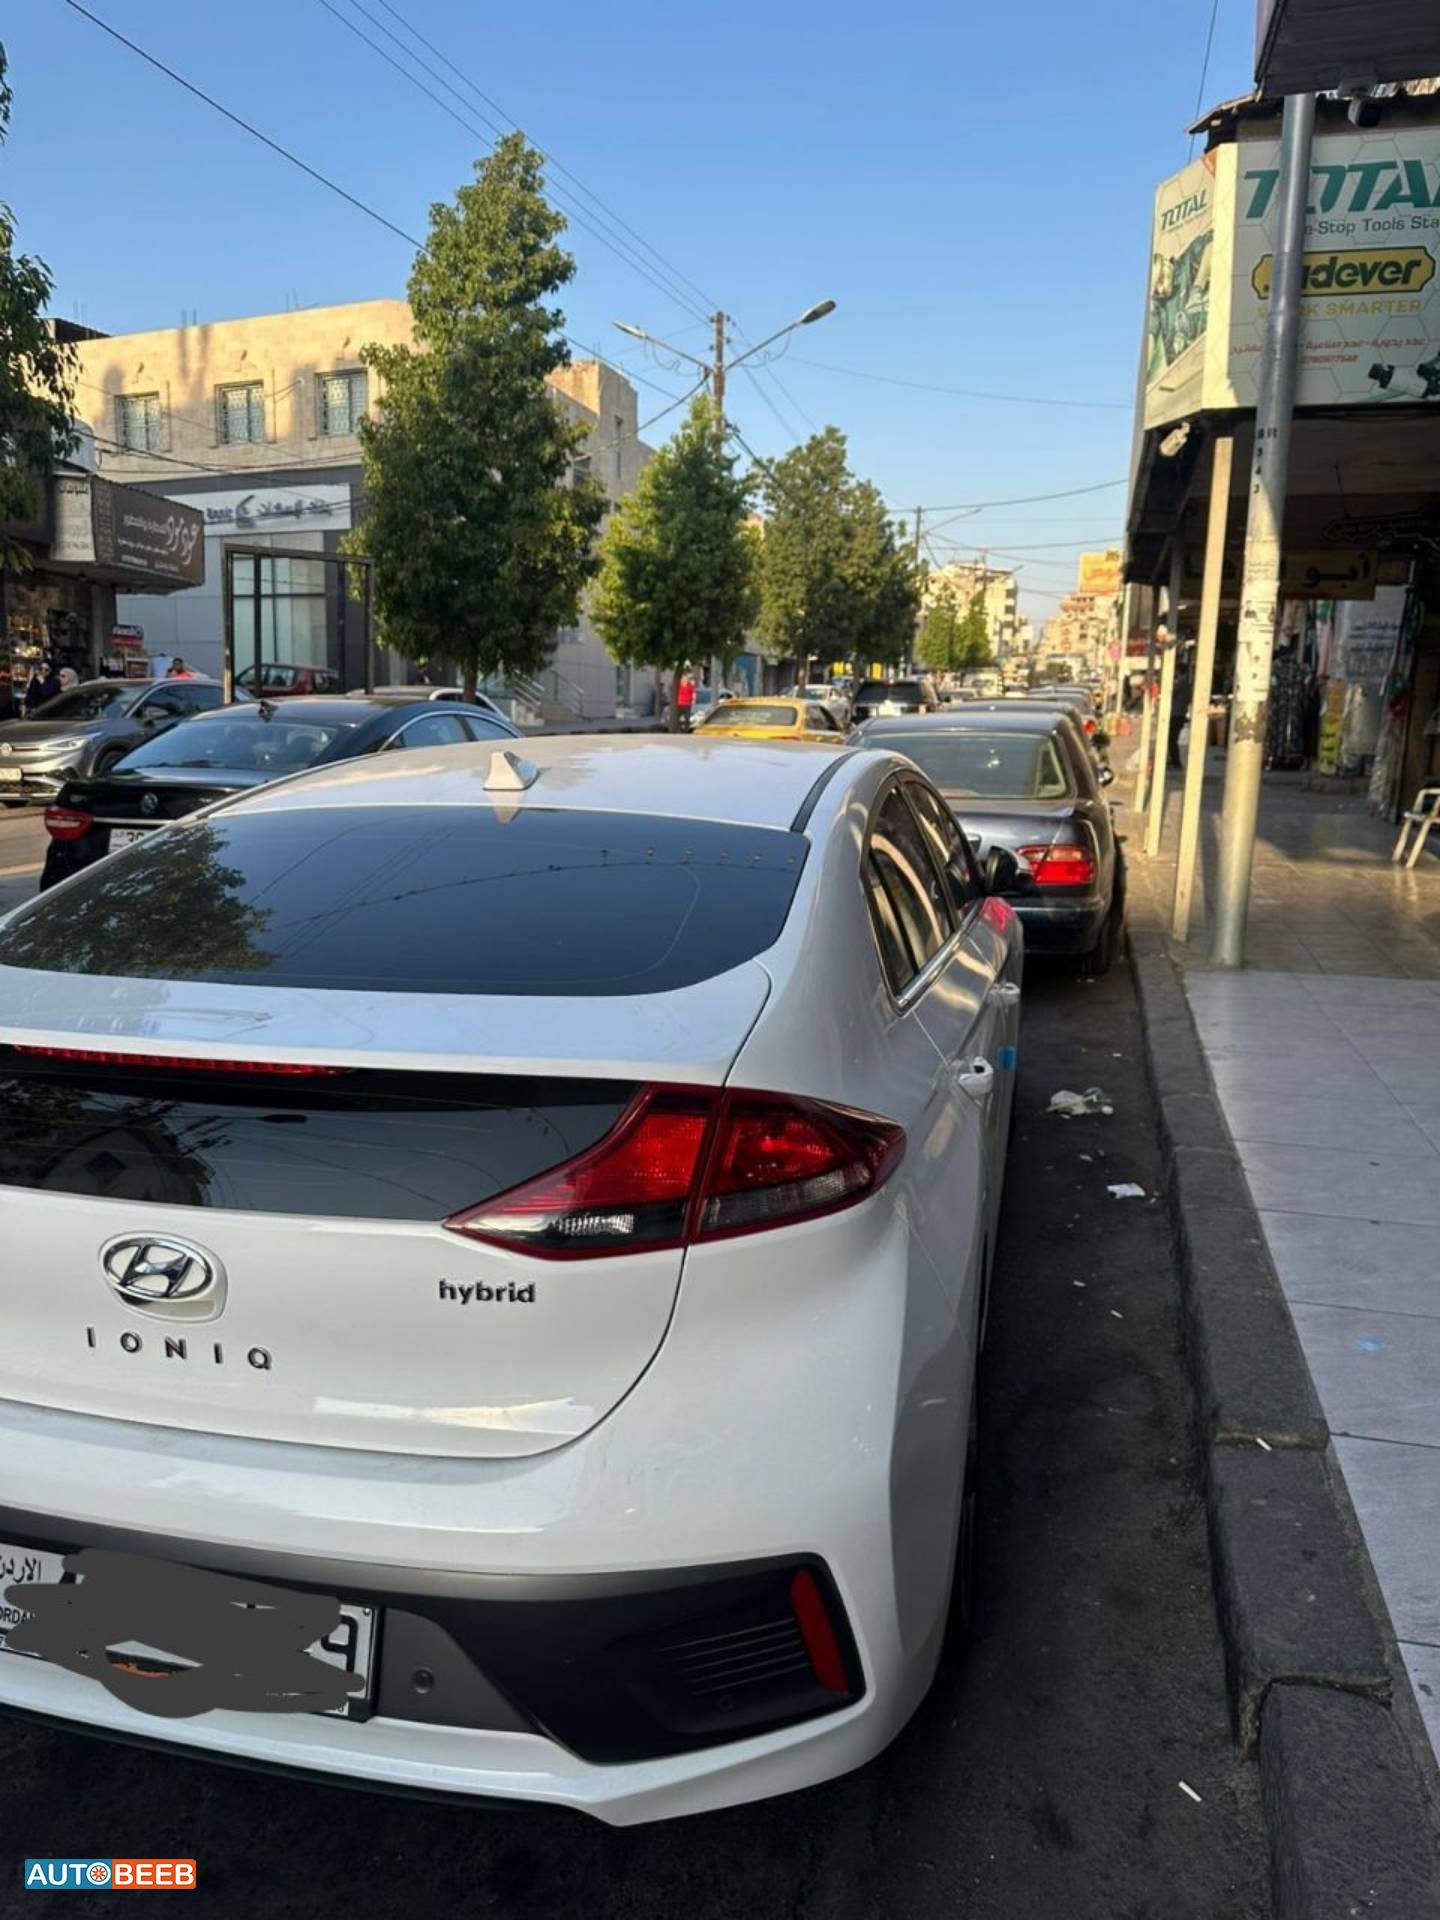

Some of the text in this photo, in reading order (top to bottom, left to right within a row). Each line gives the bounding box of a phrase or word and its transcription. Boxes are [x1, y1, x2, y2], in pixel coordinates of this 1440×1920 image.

[1161, 188, 1208, 230] TOTAL
[1363, 217, 1405, 232] Tools
[1326, 300, 1422, 316] SMARTER
[438, 1278, 536, 1305] hybrid
[86, 1326, 273, 1370] IONIQ
